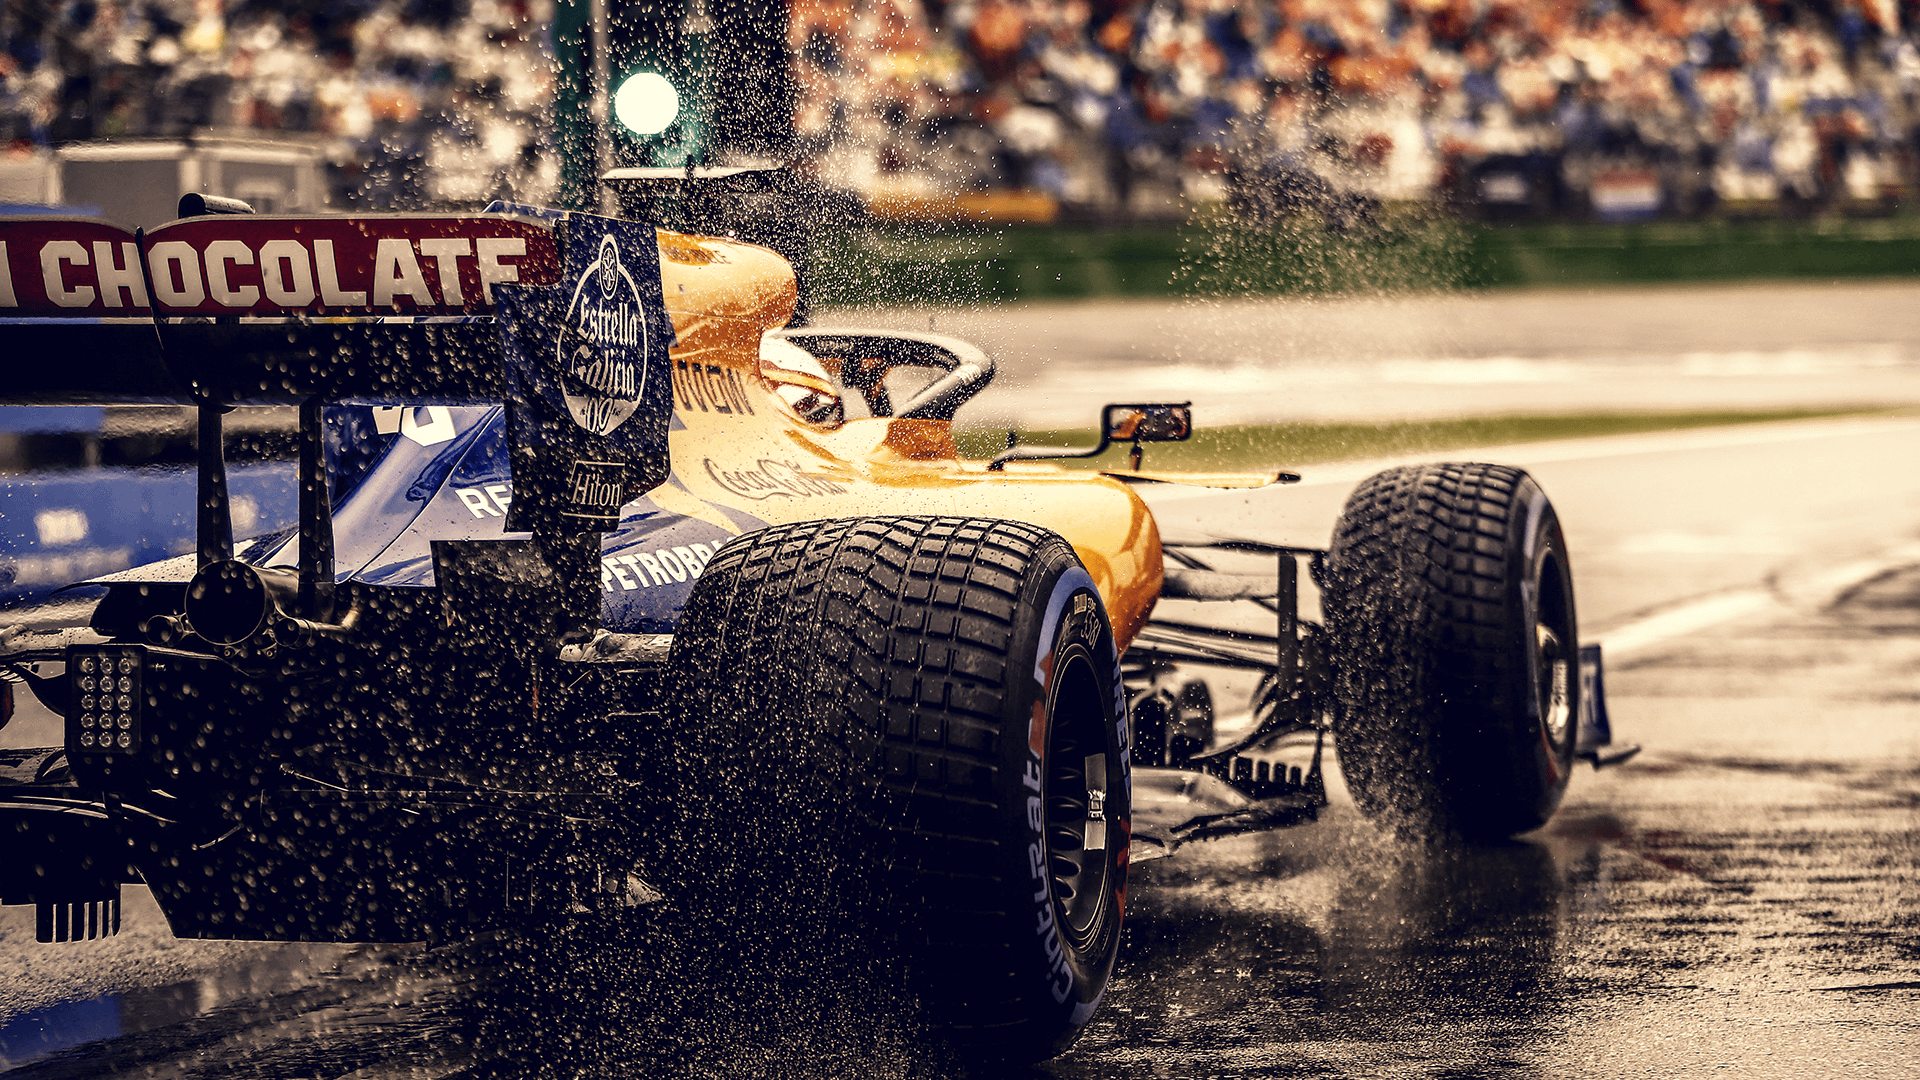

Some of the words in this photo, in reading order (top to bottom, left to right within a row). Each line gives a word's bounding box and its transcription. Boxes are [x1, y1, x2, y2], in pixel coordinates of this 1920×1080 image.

[40, 239, 527, 307] CHOCOLATE
[577, 294, 638, 347] Estrella
[571, 345, 636, 397] Galicia
[601, 538, 732, 592] PETROBR
